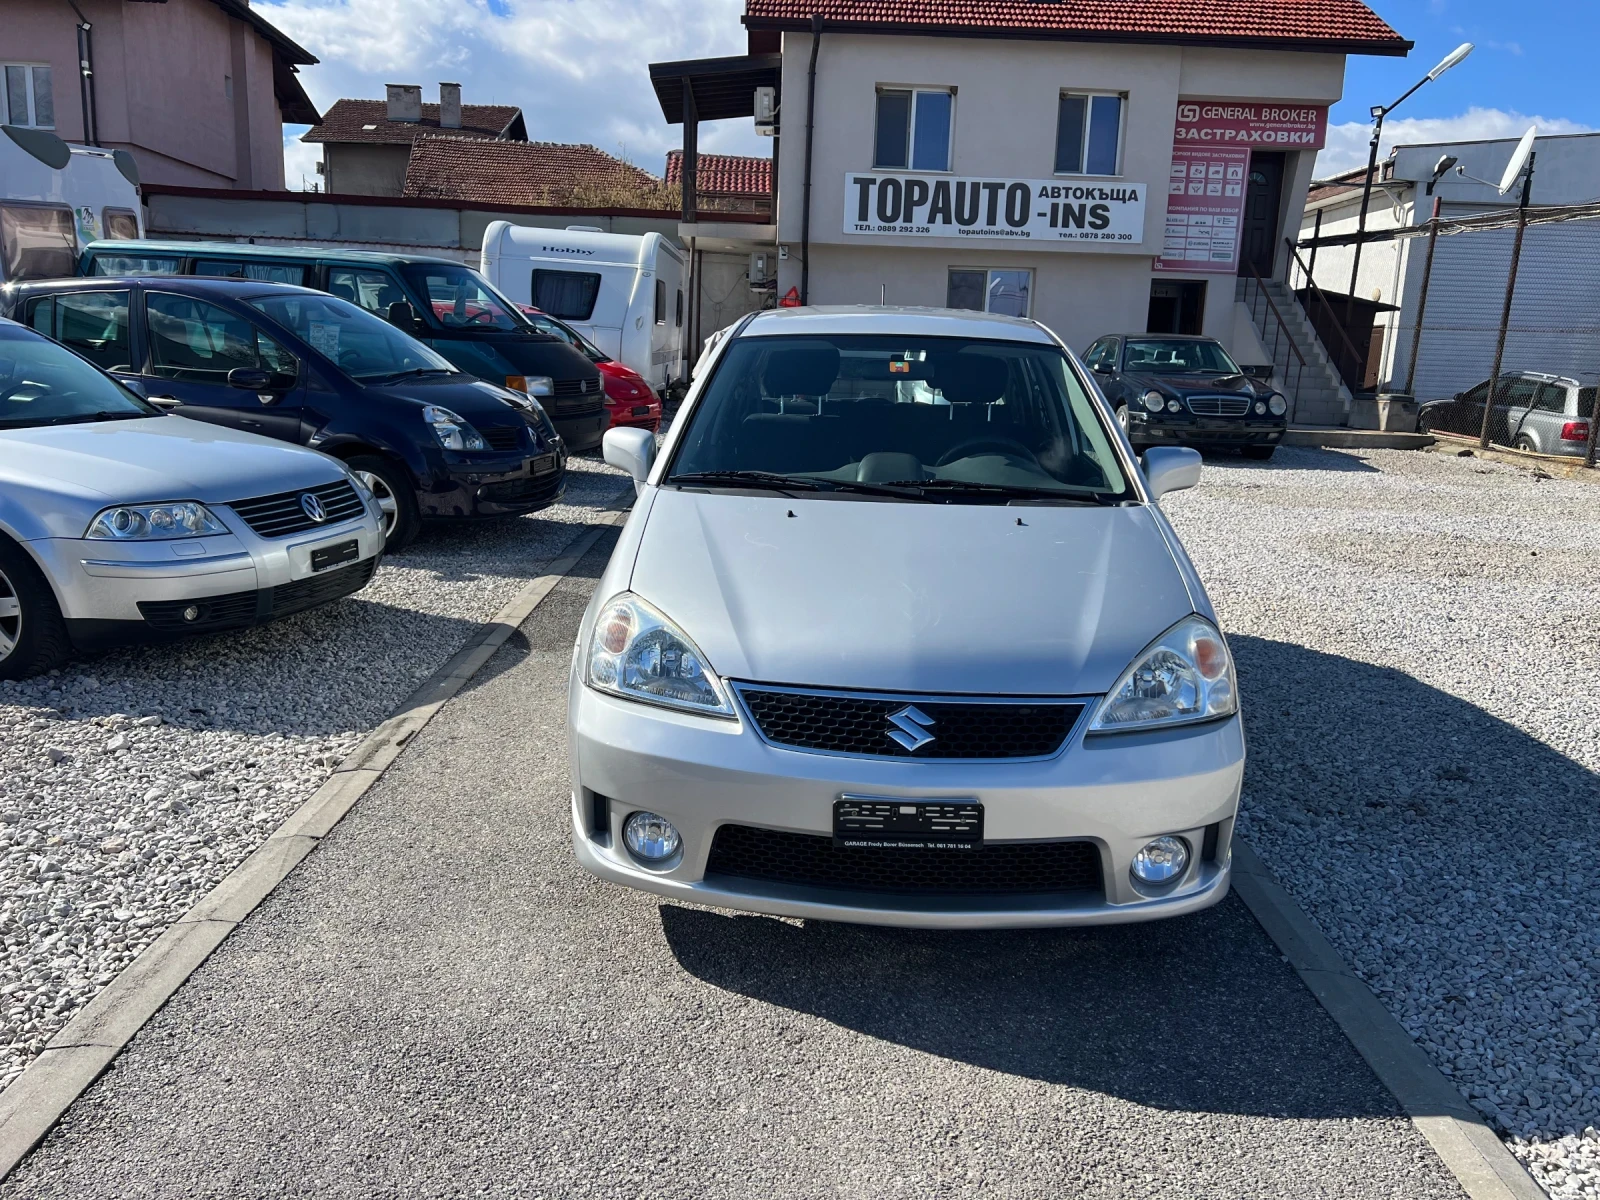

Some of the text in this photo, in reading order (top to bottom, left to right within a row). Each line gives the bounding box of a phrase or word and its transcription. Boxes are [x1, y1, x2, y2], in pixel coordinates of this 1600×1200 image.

[1202, 106, 1317, 122] GENERAL BROKER
[1249, 121, 1316, 130] www.generalbroker.bg
[1175, 128, 1315, 144] ЗАСТРАХОВКИ
[1038, 186, 1139, 204] АВТОКЪЩА
[853, 177, 1031, 228] TOPAUTO
[854, 224, 875, 232] ТЕЛ.:
[958, 228, 1030, 238] topautoins@abv.bg
[542, 246, 596, 256] Hobby
